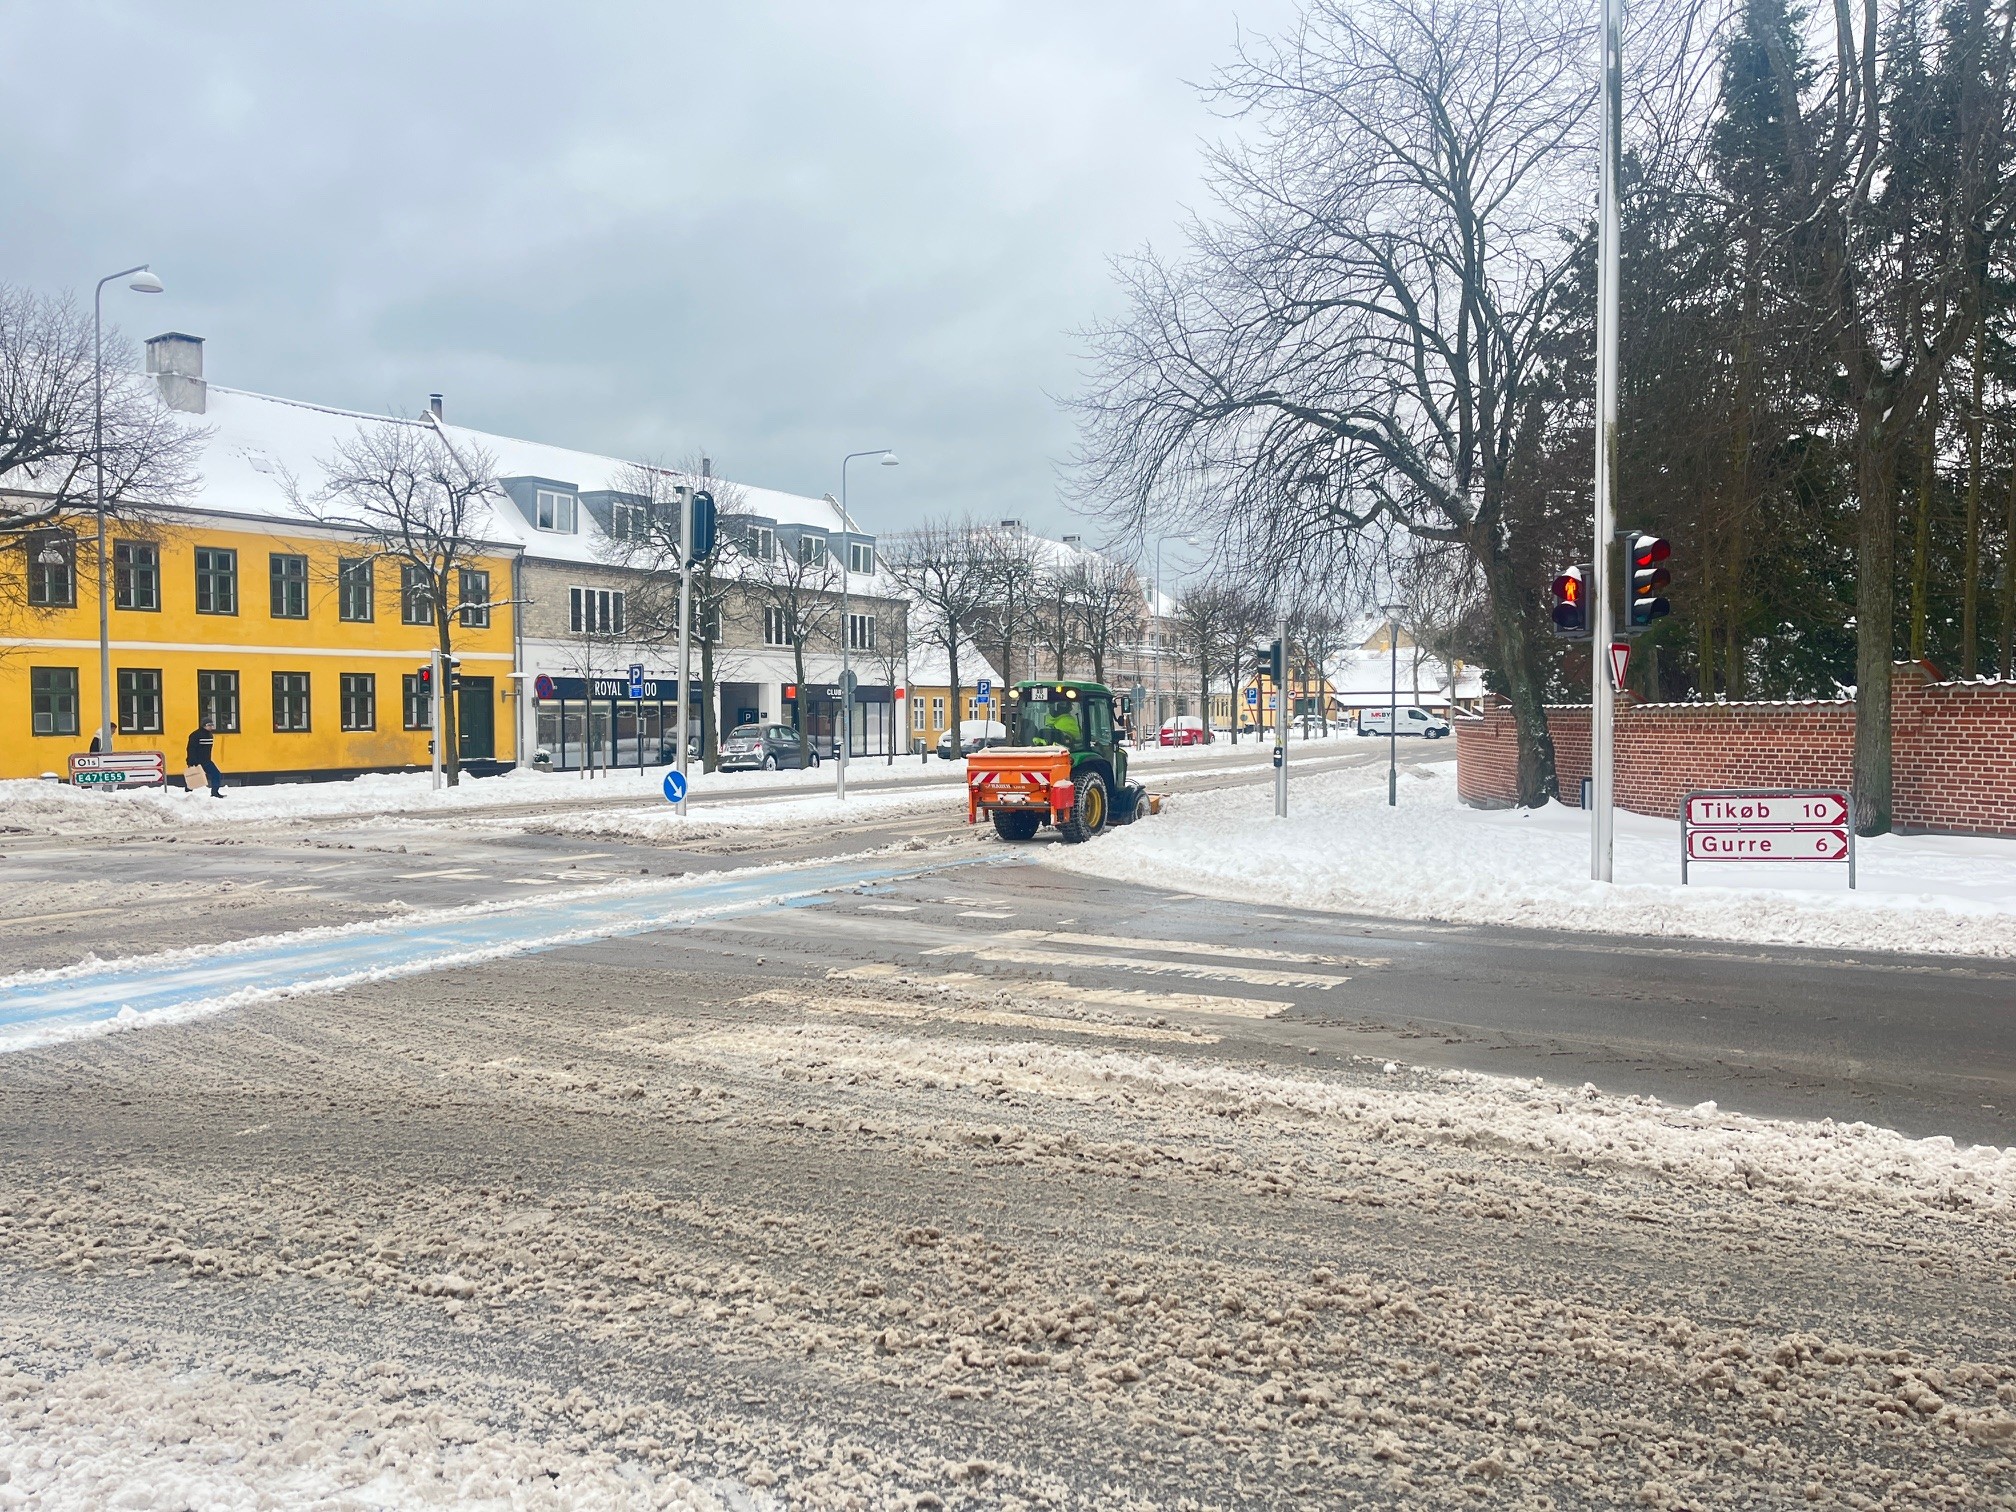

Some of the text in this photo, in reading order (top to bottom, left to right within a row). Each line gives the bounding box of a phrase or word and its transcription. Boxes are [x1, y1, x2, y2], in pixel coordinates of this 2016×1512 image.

[632, 668, 640, 684] P
[594, 681, 622, 696] ROYAL
[980, 682, 988, 695] P
[1249, 690, 1255, 698] P
[745, 713, 751, 721] P
[78, 773, 123, 782] E47 E55
[1701, 802, 1827, 818] Tikøb 10
[1702, 836, 1828, 852] Gurre 6
